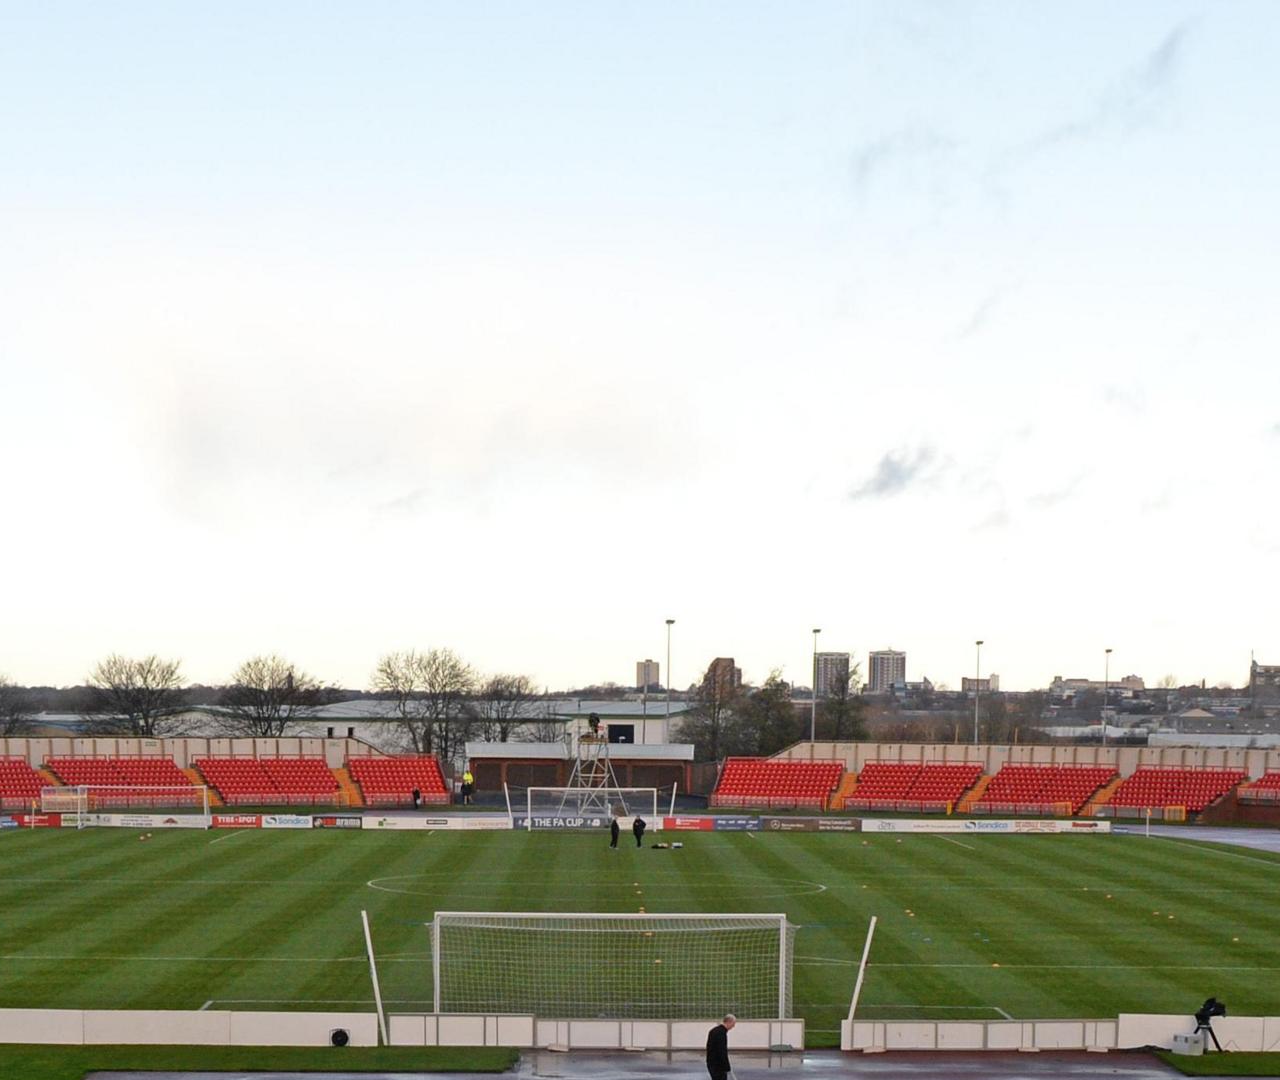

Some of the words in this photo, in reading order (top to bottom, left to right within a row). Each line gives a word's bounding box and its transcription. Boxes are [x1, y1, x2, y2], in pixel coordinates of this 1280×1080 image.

[534, 818, 552, 827] THE
[553, 818, 565, 827] FA
[566, 818, 584, 827] CUP
